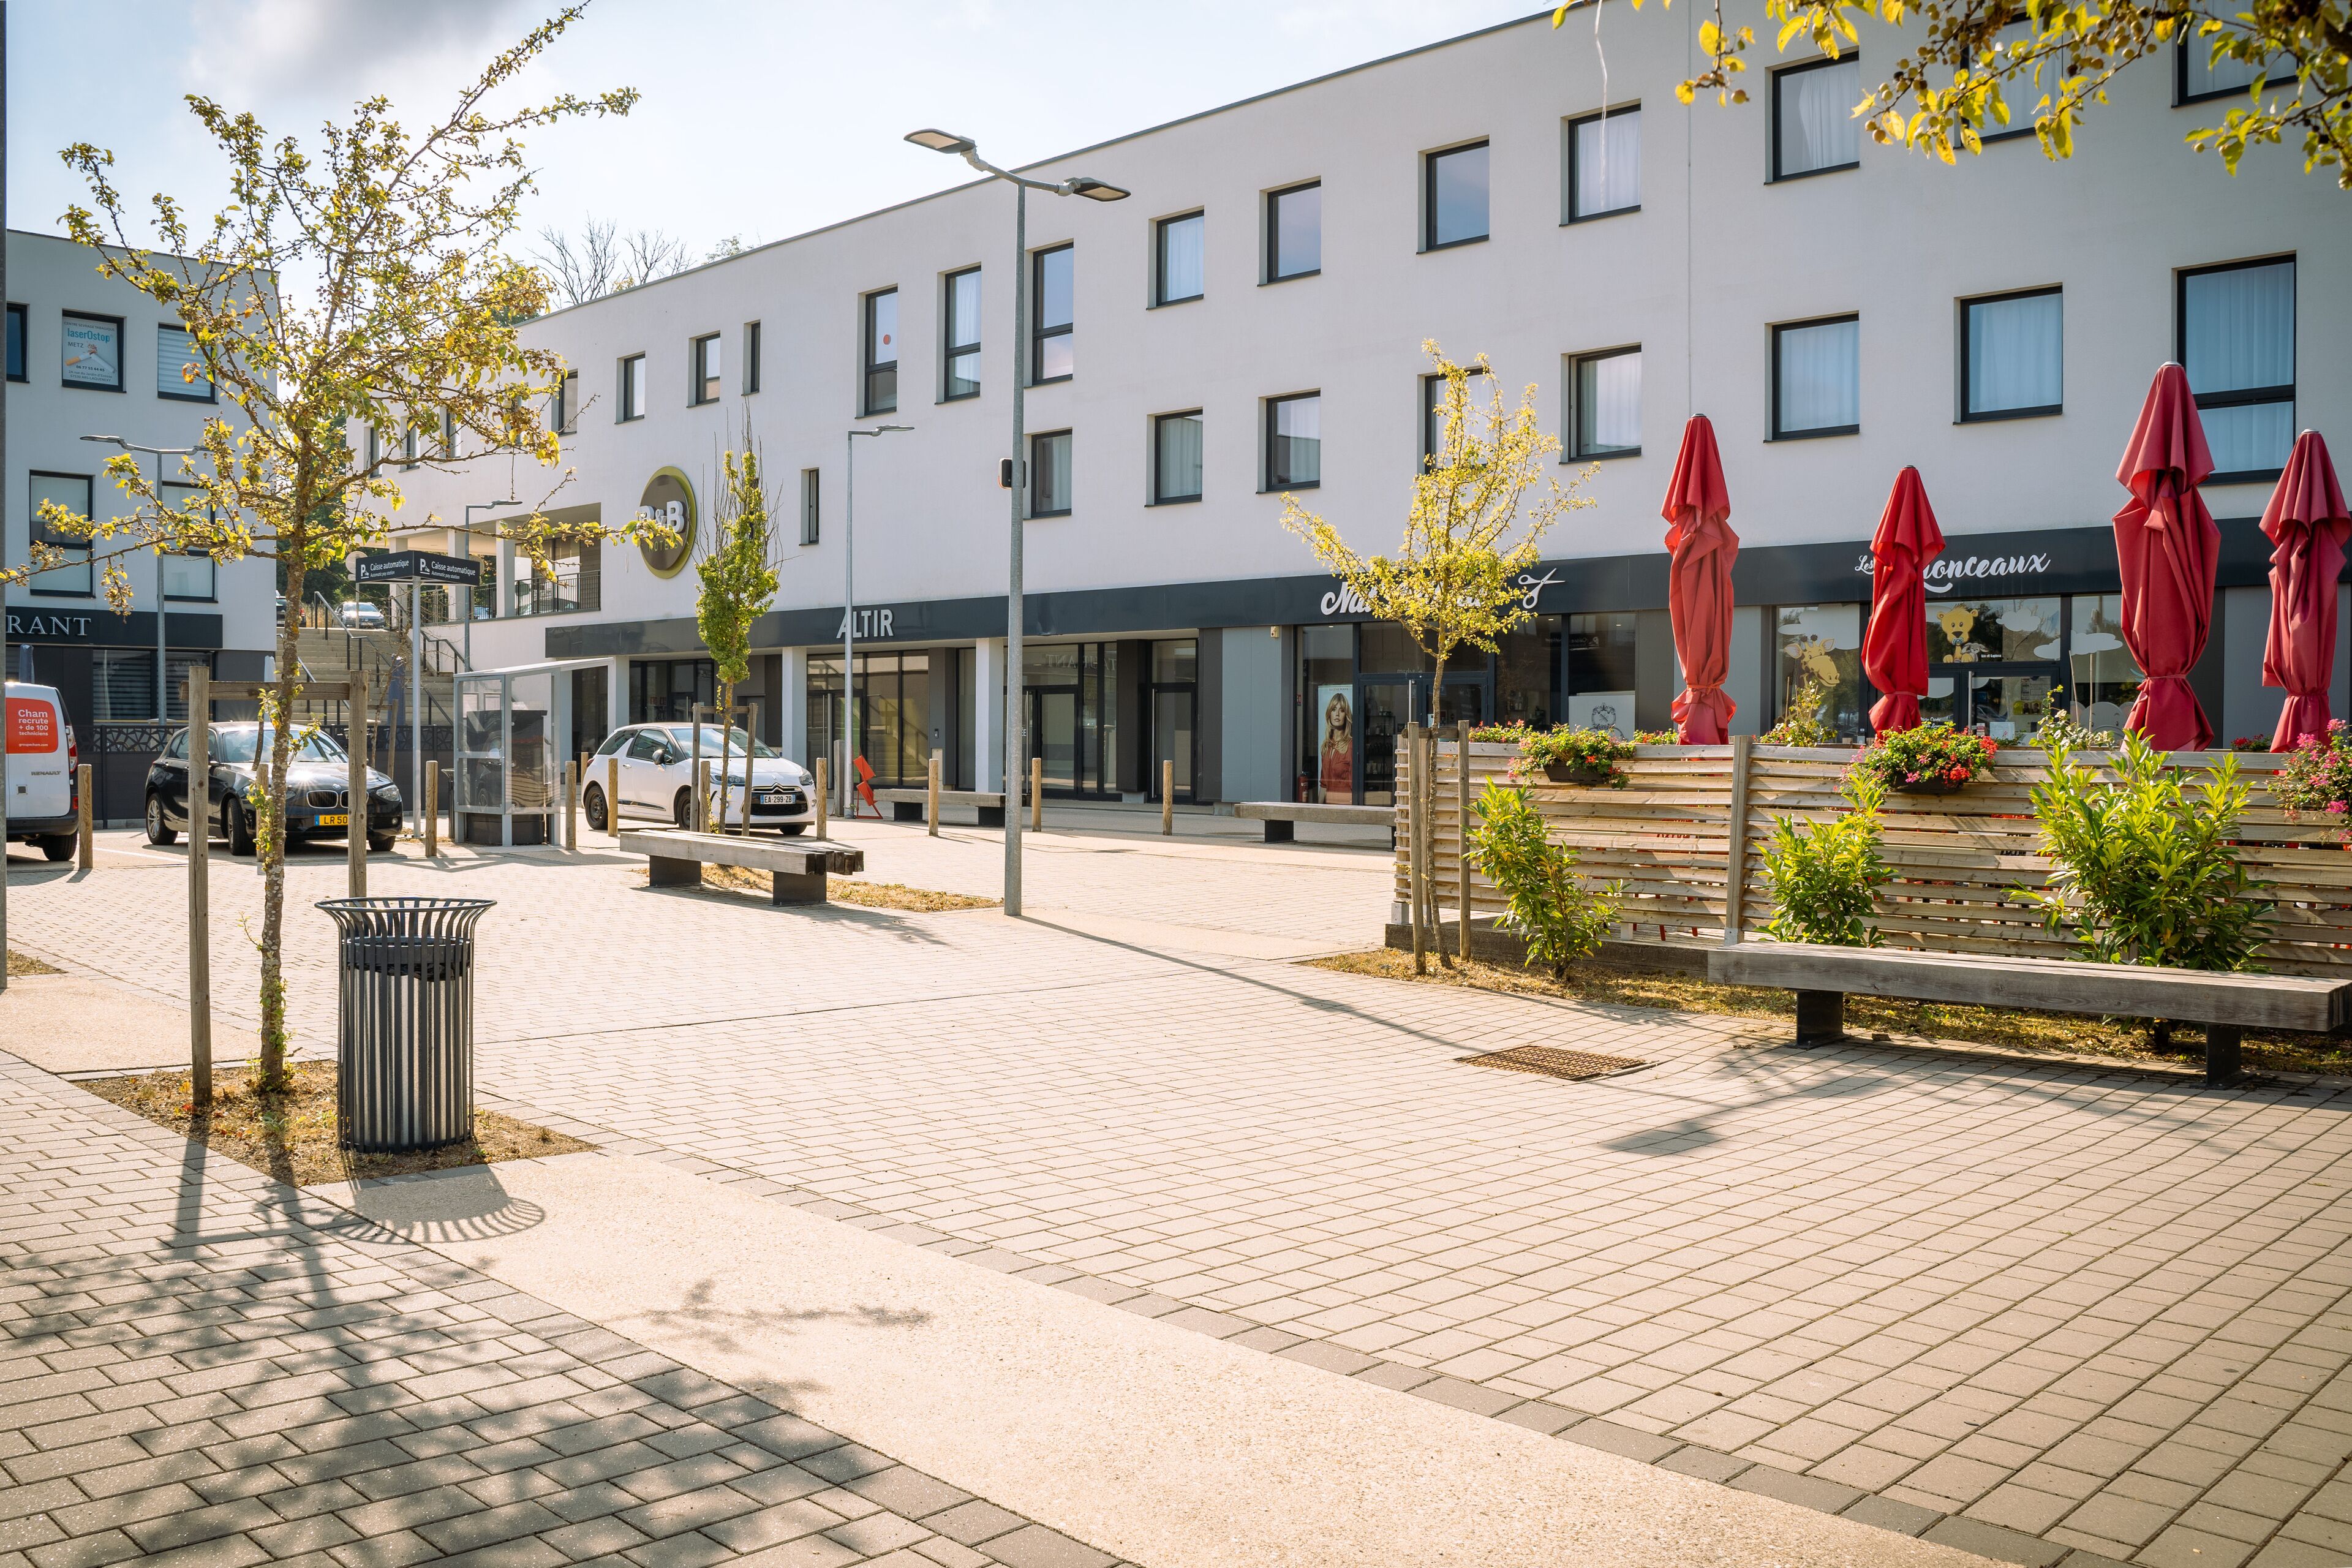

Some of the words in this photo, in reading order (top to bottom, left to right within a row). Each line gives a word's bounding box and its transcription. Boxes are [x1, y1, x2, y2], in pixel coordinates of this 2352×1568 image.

[383, 559, 409, 569] automatique
[431, 561, 446, 571] Caisse
[447, 565, 476, 576] automatique
[1923, 552, 2051, 594] onceaux
[6, 615, 91, 636] RANT
[835, 609, 894, 639] ALTIR
